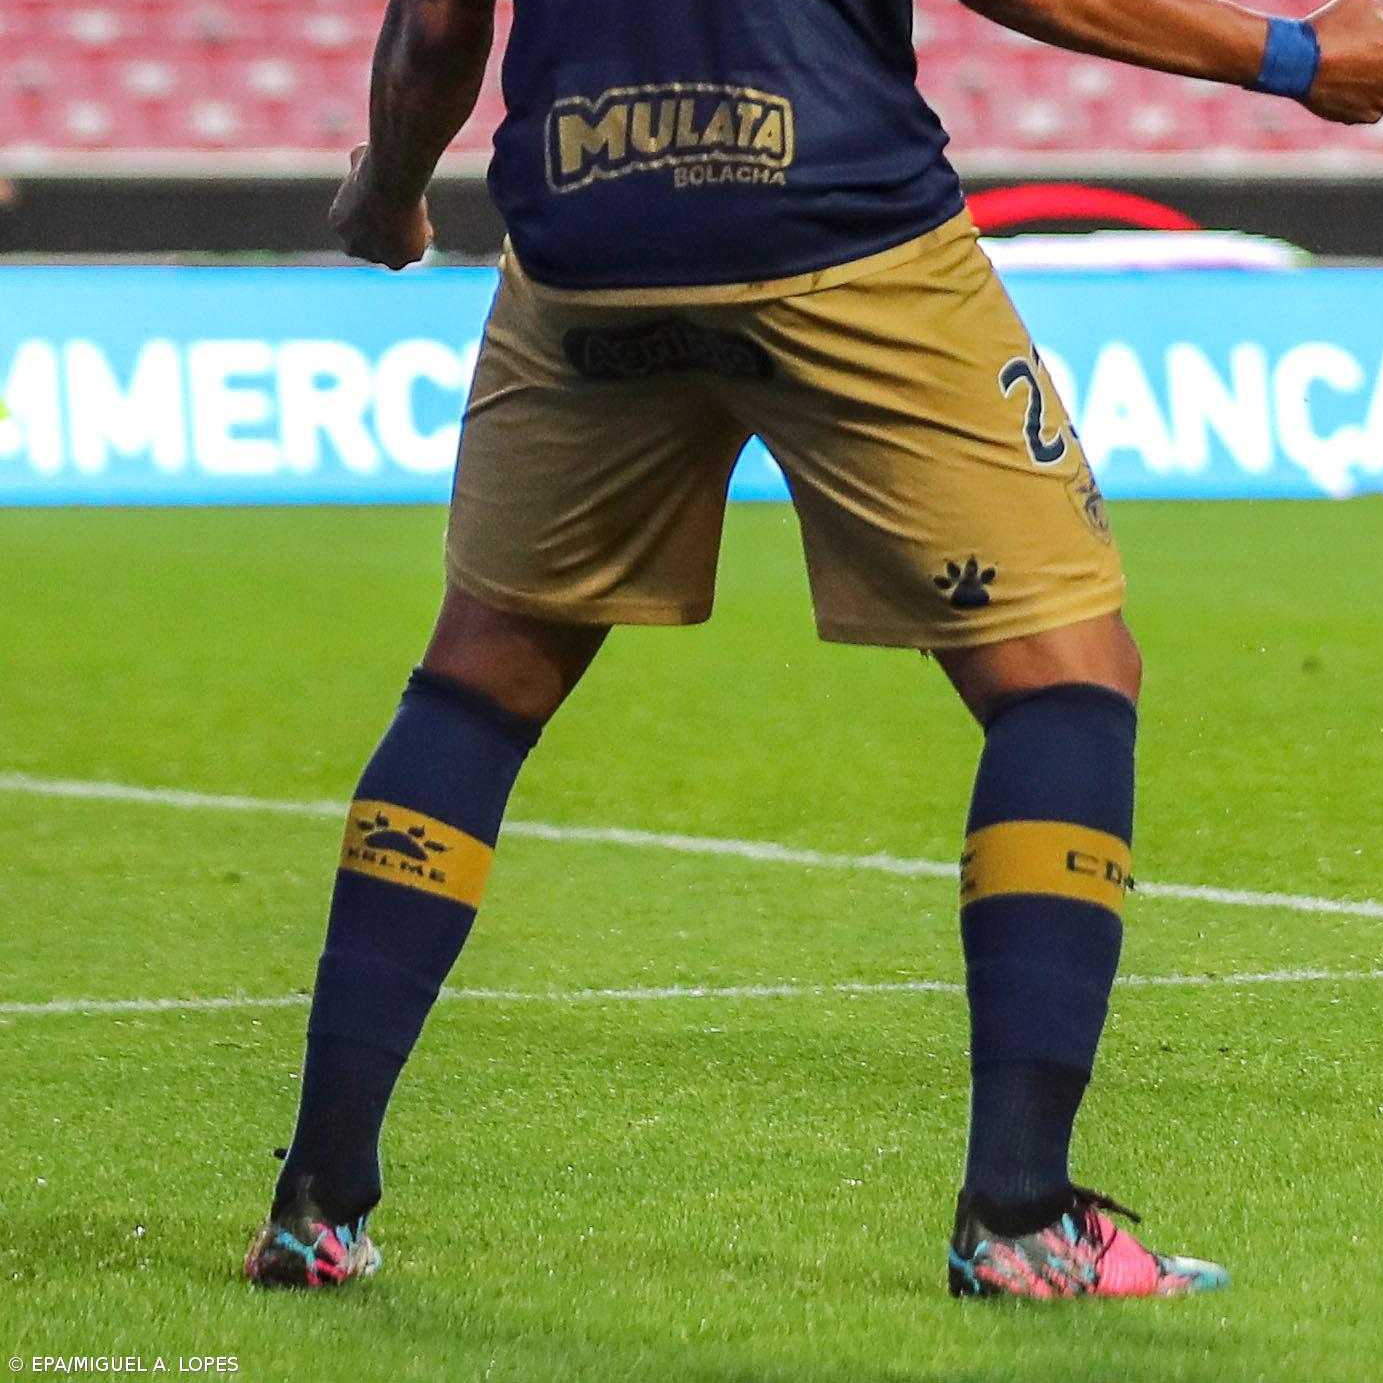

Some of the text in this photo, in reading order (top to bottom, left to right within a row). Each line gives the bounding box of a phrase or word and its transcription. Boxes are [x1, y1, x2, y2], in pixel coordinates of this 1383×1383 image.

[558, 98, 782, 175] MULATA
[674, 166, 786, 188] BOLACHA
[998, 348, 1078, 465] 2
